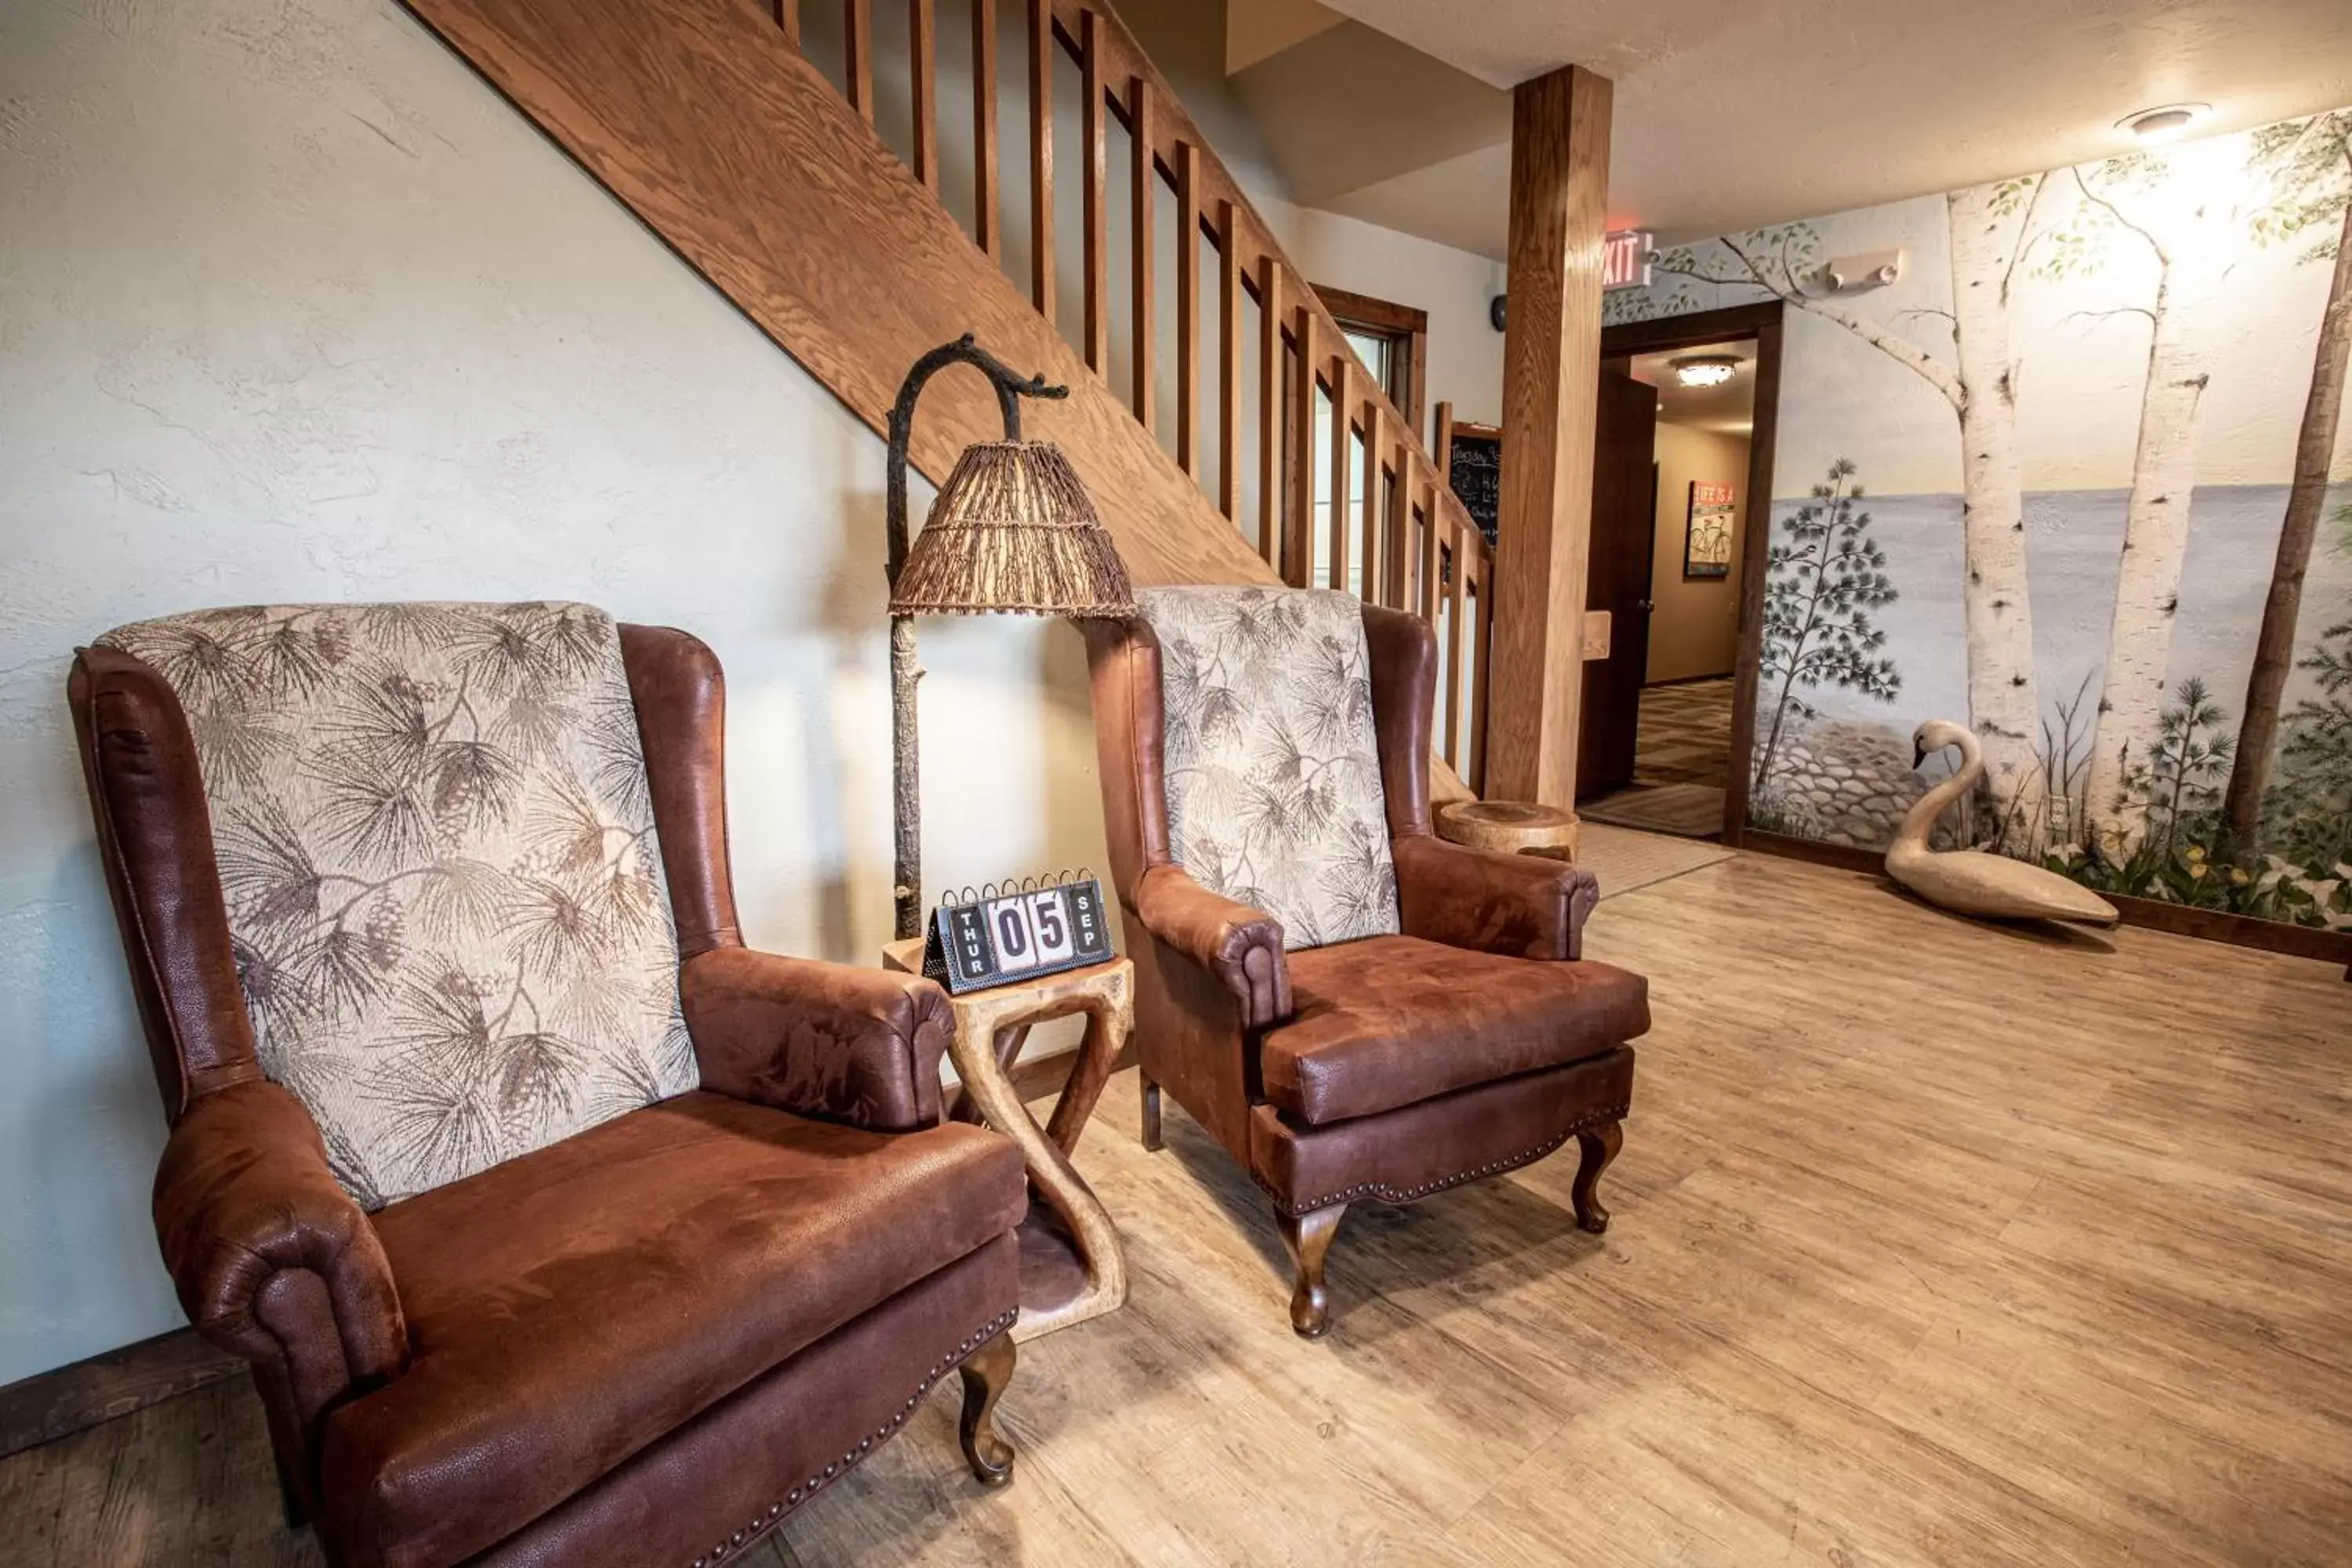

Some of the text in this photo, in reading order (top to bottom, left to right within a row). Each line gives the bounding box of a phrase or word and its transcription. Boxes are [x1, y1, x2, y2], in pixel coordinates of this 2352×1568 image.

[1602, 238, 1638, 285] XIT
[960, 913, 984, 974] THUR
[997, 901, 1065, 957] 05
[1077, 896, 1095, 946] SEP
